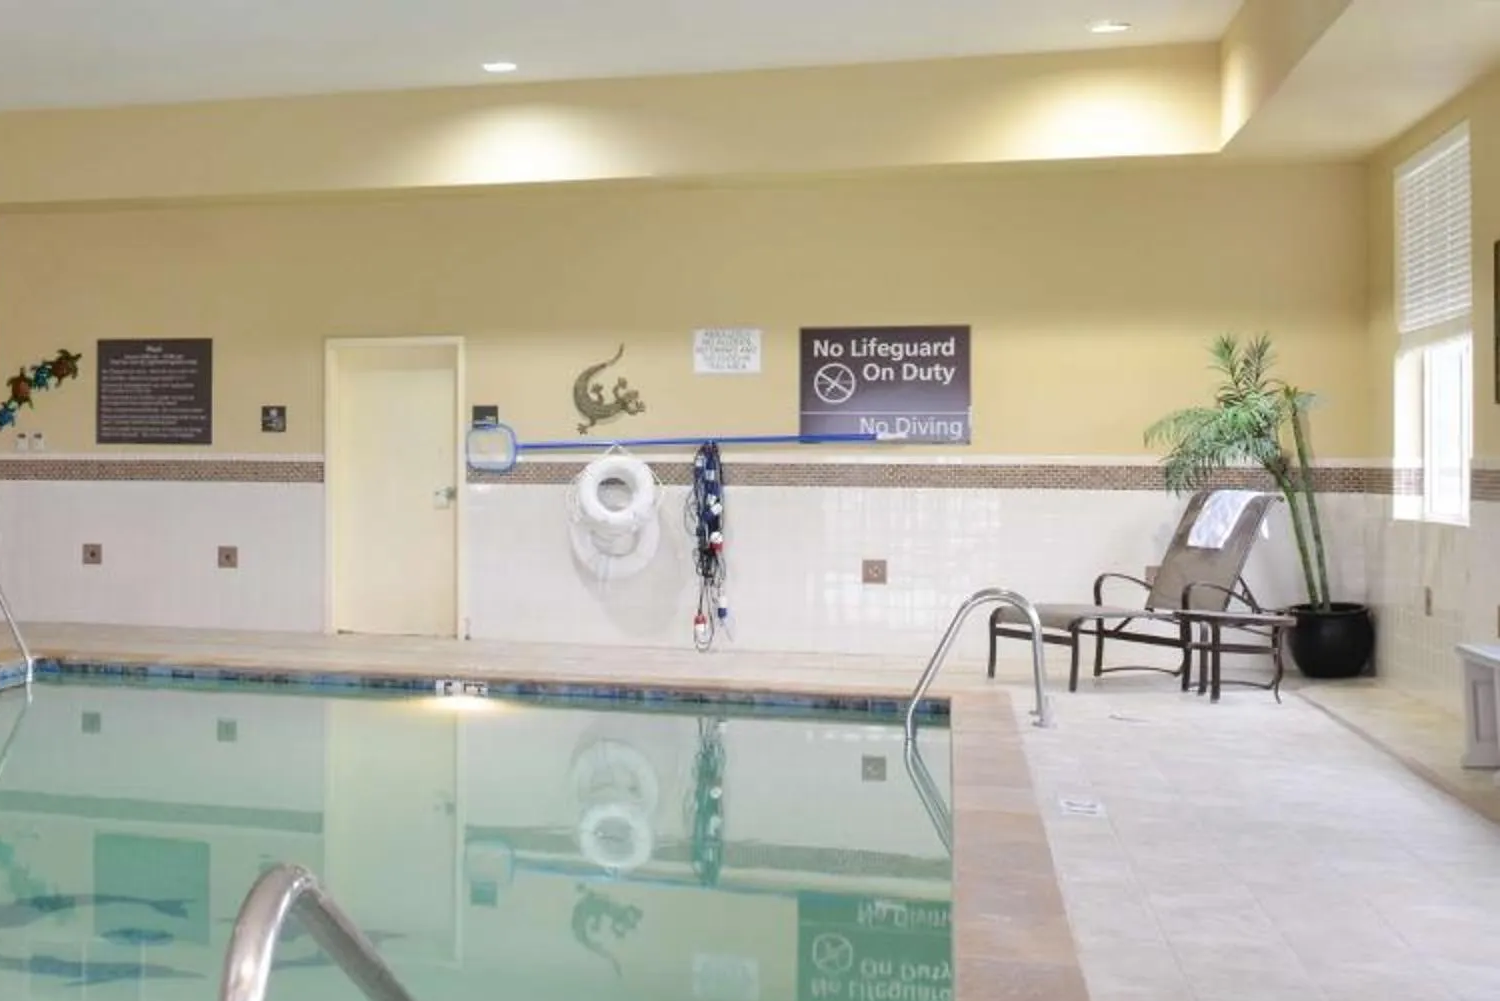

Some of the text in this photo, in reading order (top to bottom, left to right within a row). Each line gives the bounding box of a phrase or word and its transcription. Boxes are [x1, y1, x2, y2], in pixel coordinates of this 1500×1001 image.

[813, 337, 956, 361] No Lifeguard
[862, 363, 956, 385] On Duty
[859, 417, 963, 440] No Diving
